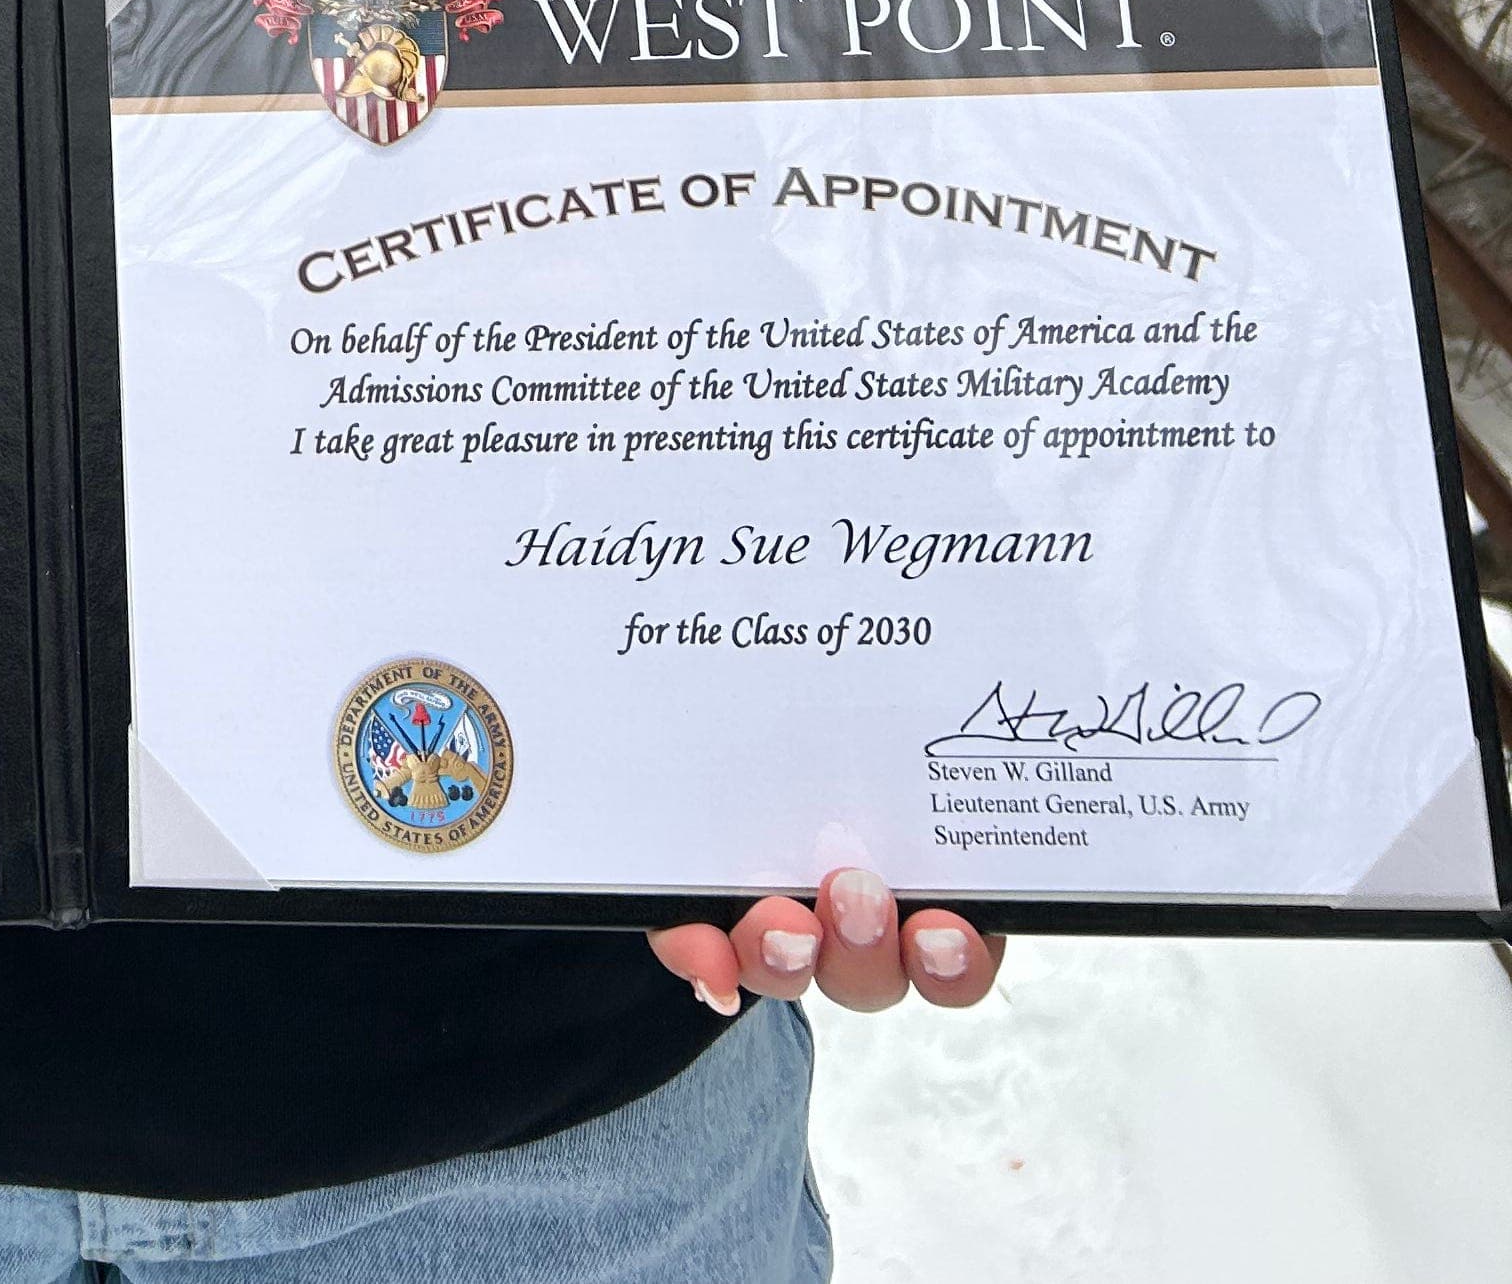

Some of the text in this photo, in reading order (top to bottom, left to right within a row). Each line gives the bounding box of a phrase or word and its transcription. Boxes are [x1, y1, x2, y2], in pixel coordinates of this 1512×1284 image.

[296, 165, 1218, 294] CERTIFICATE OF APPOINTMENT
[290, 310, 1259, 363] On behalf of the President of the United States of America and the
[320, 362, 1231, 411] Admissions Committee of the United States Military Academy
[289, 415, 1277, 464] I take great pleasure in presenting this certificate of appointment to
[503, 518, 1095, 583] Haidyn Sue Wegmann
[616, 610, 933, 657] for the Class of 2030
[340, 666, 413, 747] DEPARTMENT
[421, 666, 443, 680] OF
[449, 673, 480, 701] THE
[477, 703, 508, 748] ARMY
[927, 761, 1114, 783] Steven W. Gilland
[341, 760, 507, 845] UNITED STATES OF AMERICA
[930, 793, 1250, 821] Lieutenant General, U.S. Army
[934, 825, 1089, 850] Superintendent
